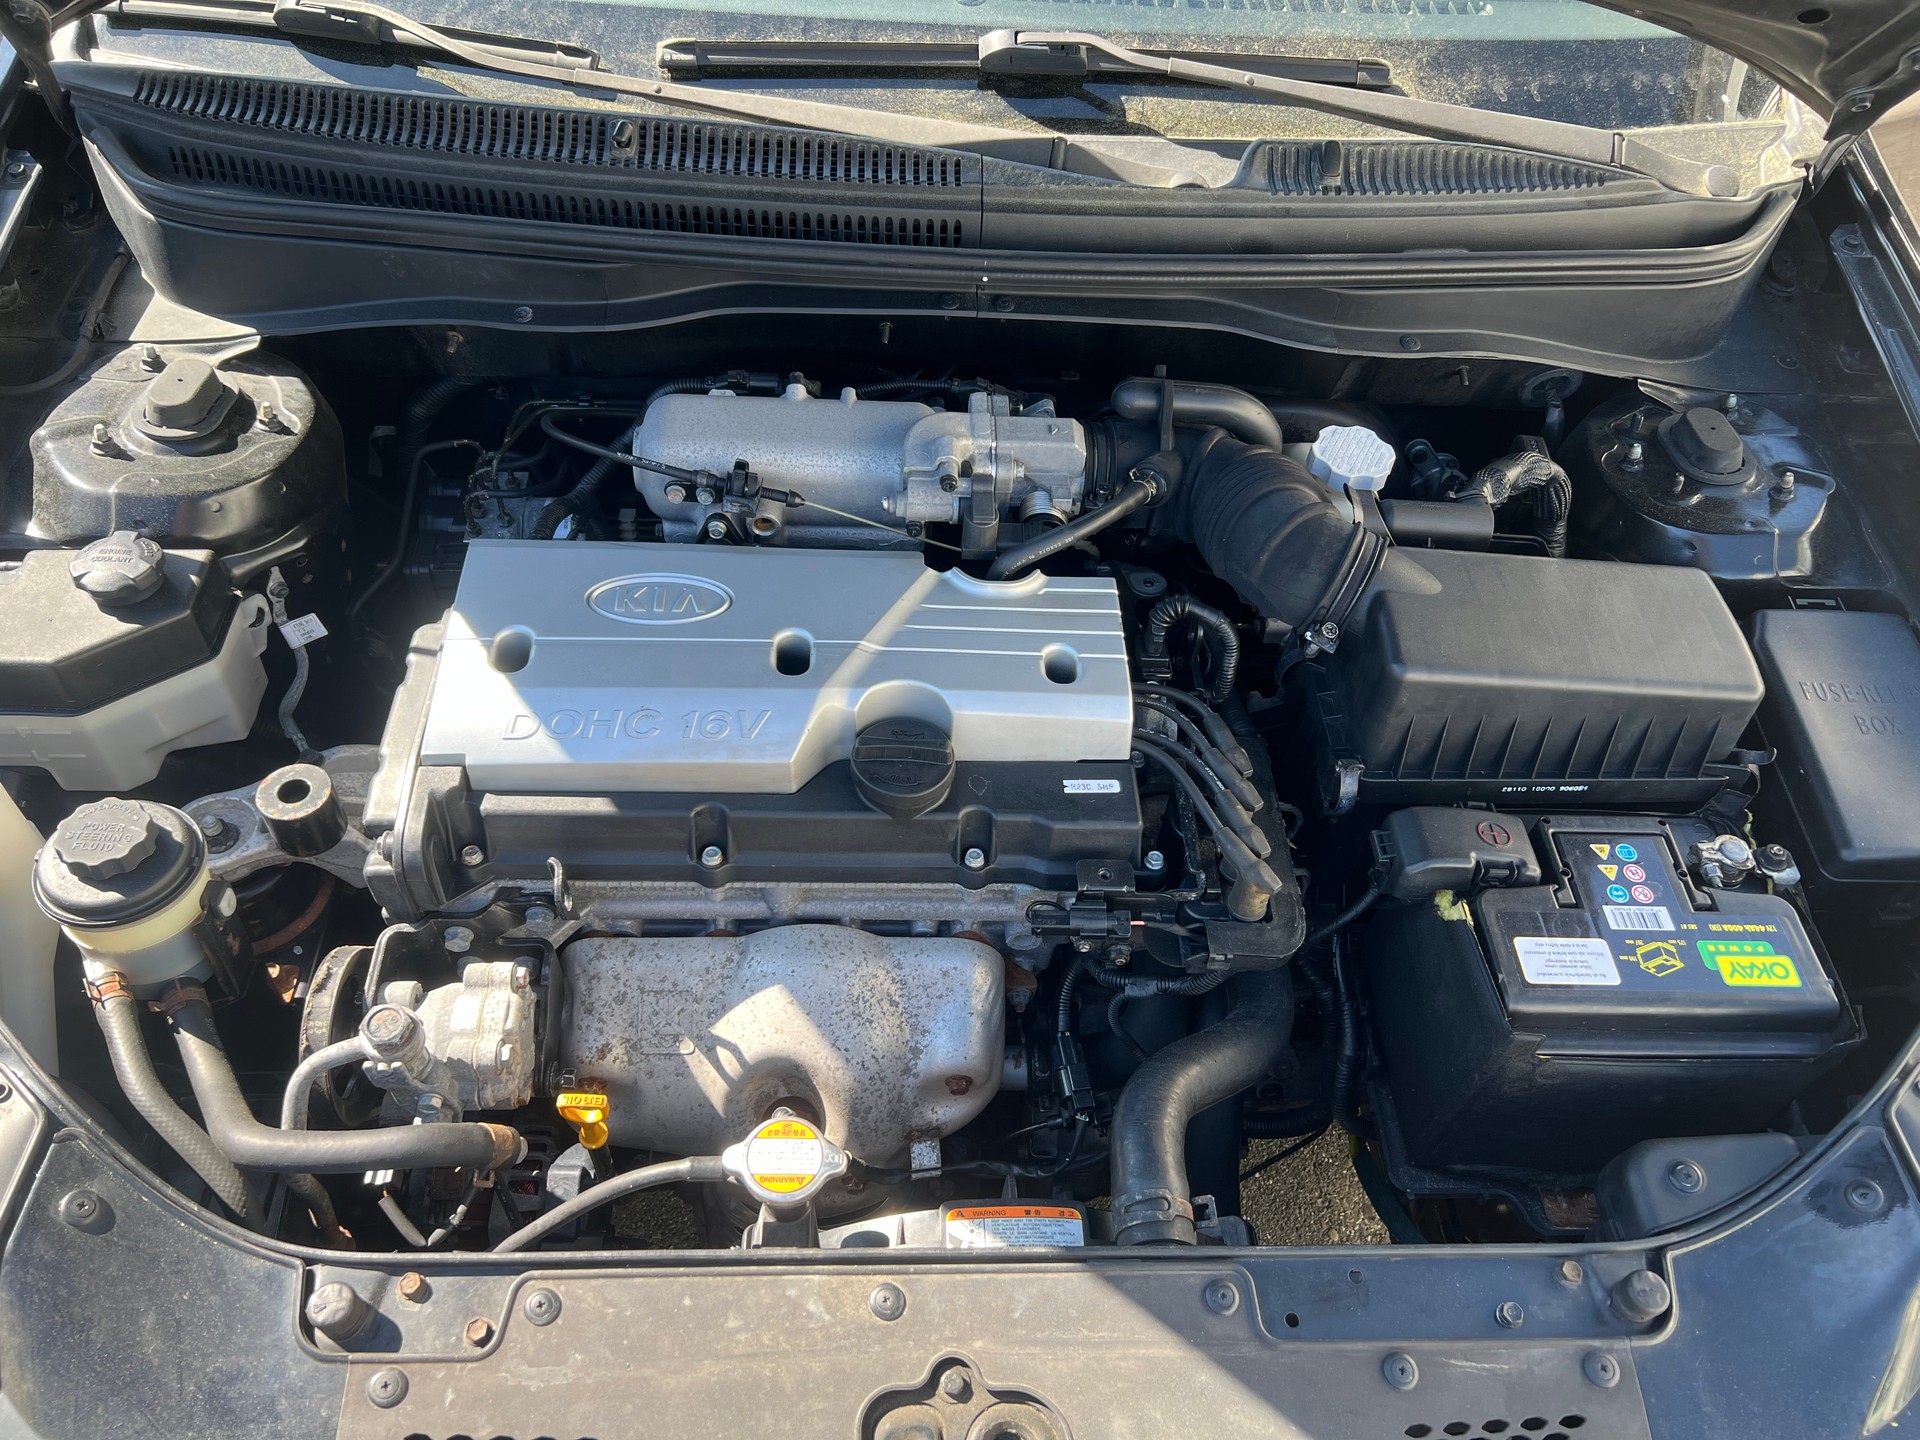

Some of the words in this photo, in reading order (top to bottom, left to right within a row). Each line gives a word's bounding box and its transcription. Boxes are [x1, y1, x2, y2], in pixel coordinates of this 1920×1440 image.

[91, 556, 134, 564] COOLANT
[613, 585, 706, 613] KIA
[502, 708, 663, 740] DOHC
[681, 709, 772, 740] 16V
[1854, 715, 1903, 736] BOX
[82, 822, 126, 833] POWER
[64, 831, 134, 843] STEERING
[71, 841, 116, 852] FLUID
[1722, 924, 1744, 932] 400A
[1744, 924, 1766, 932] 44Ah
[1706, 944, 1765, 952] POWER
[1729, 962, 1790, 980] OKAY
[563, 1096, 582, 1104] OIL
[584, 1096, 605, 1106] ENG
[760, 1176, 796, 1184] WARNING
